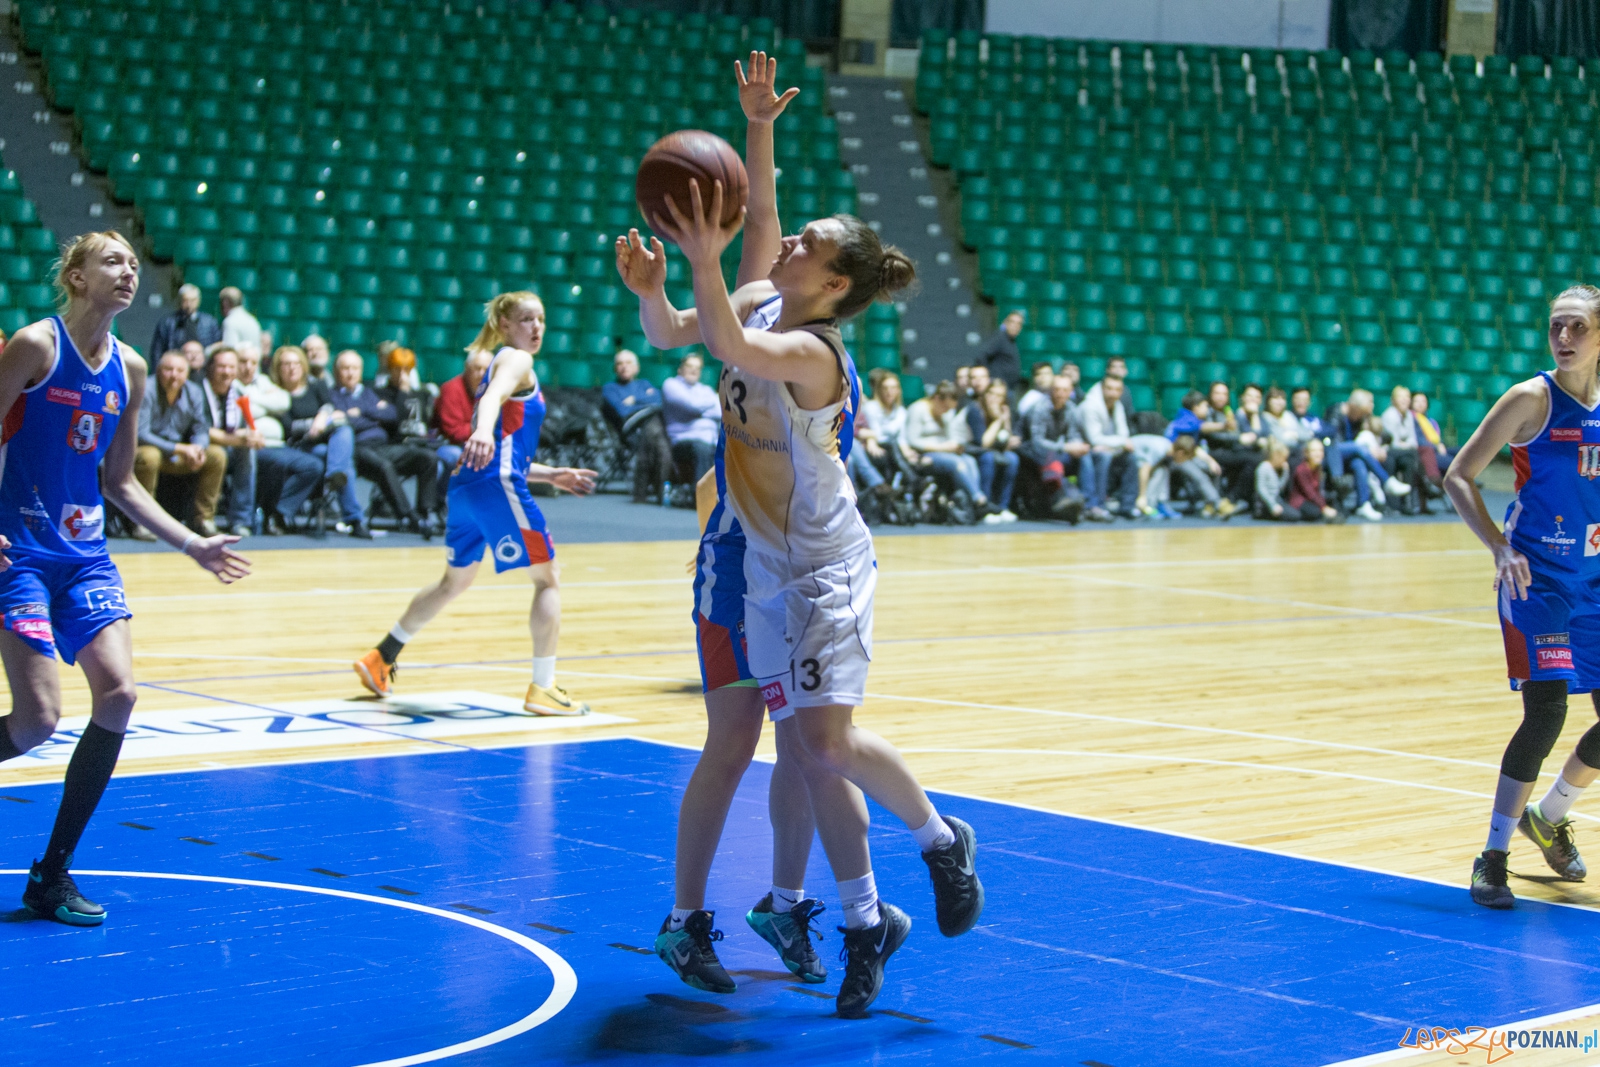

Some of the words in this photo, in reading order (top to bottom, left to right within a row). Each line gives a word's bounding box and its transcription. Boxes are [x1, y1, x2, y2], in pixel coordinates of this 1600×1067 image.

[49, 388, 81, 400] TAURON
[72, 413, 98, 451] 9
[789, 658, 822, 692] 13
